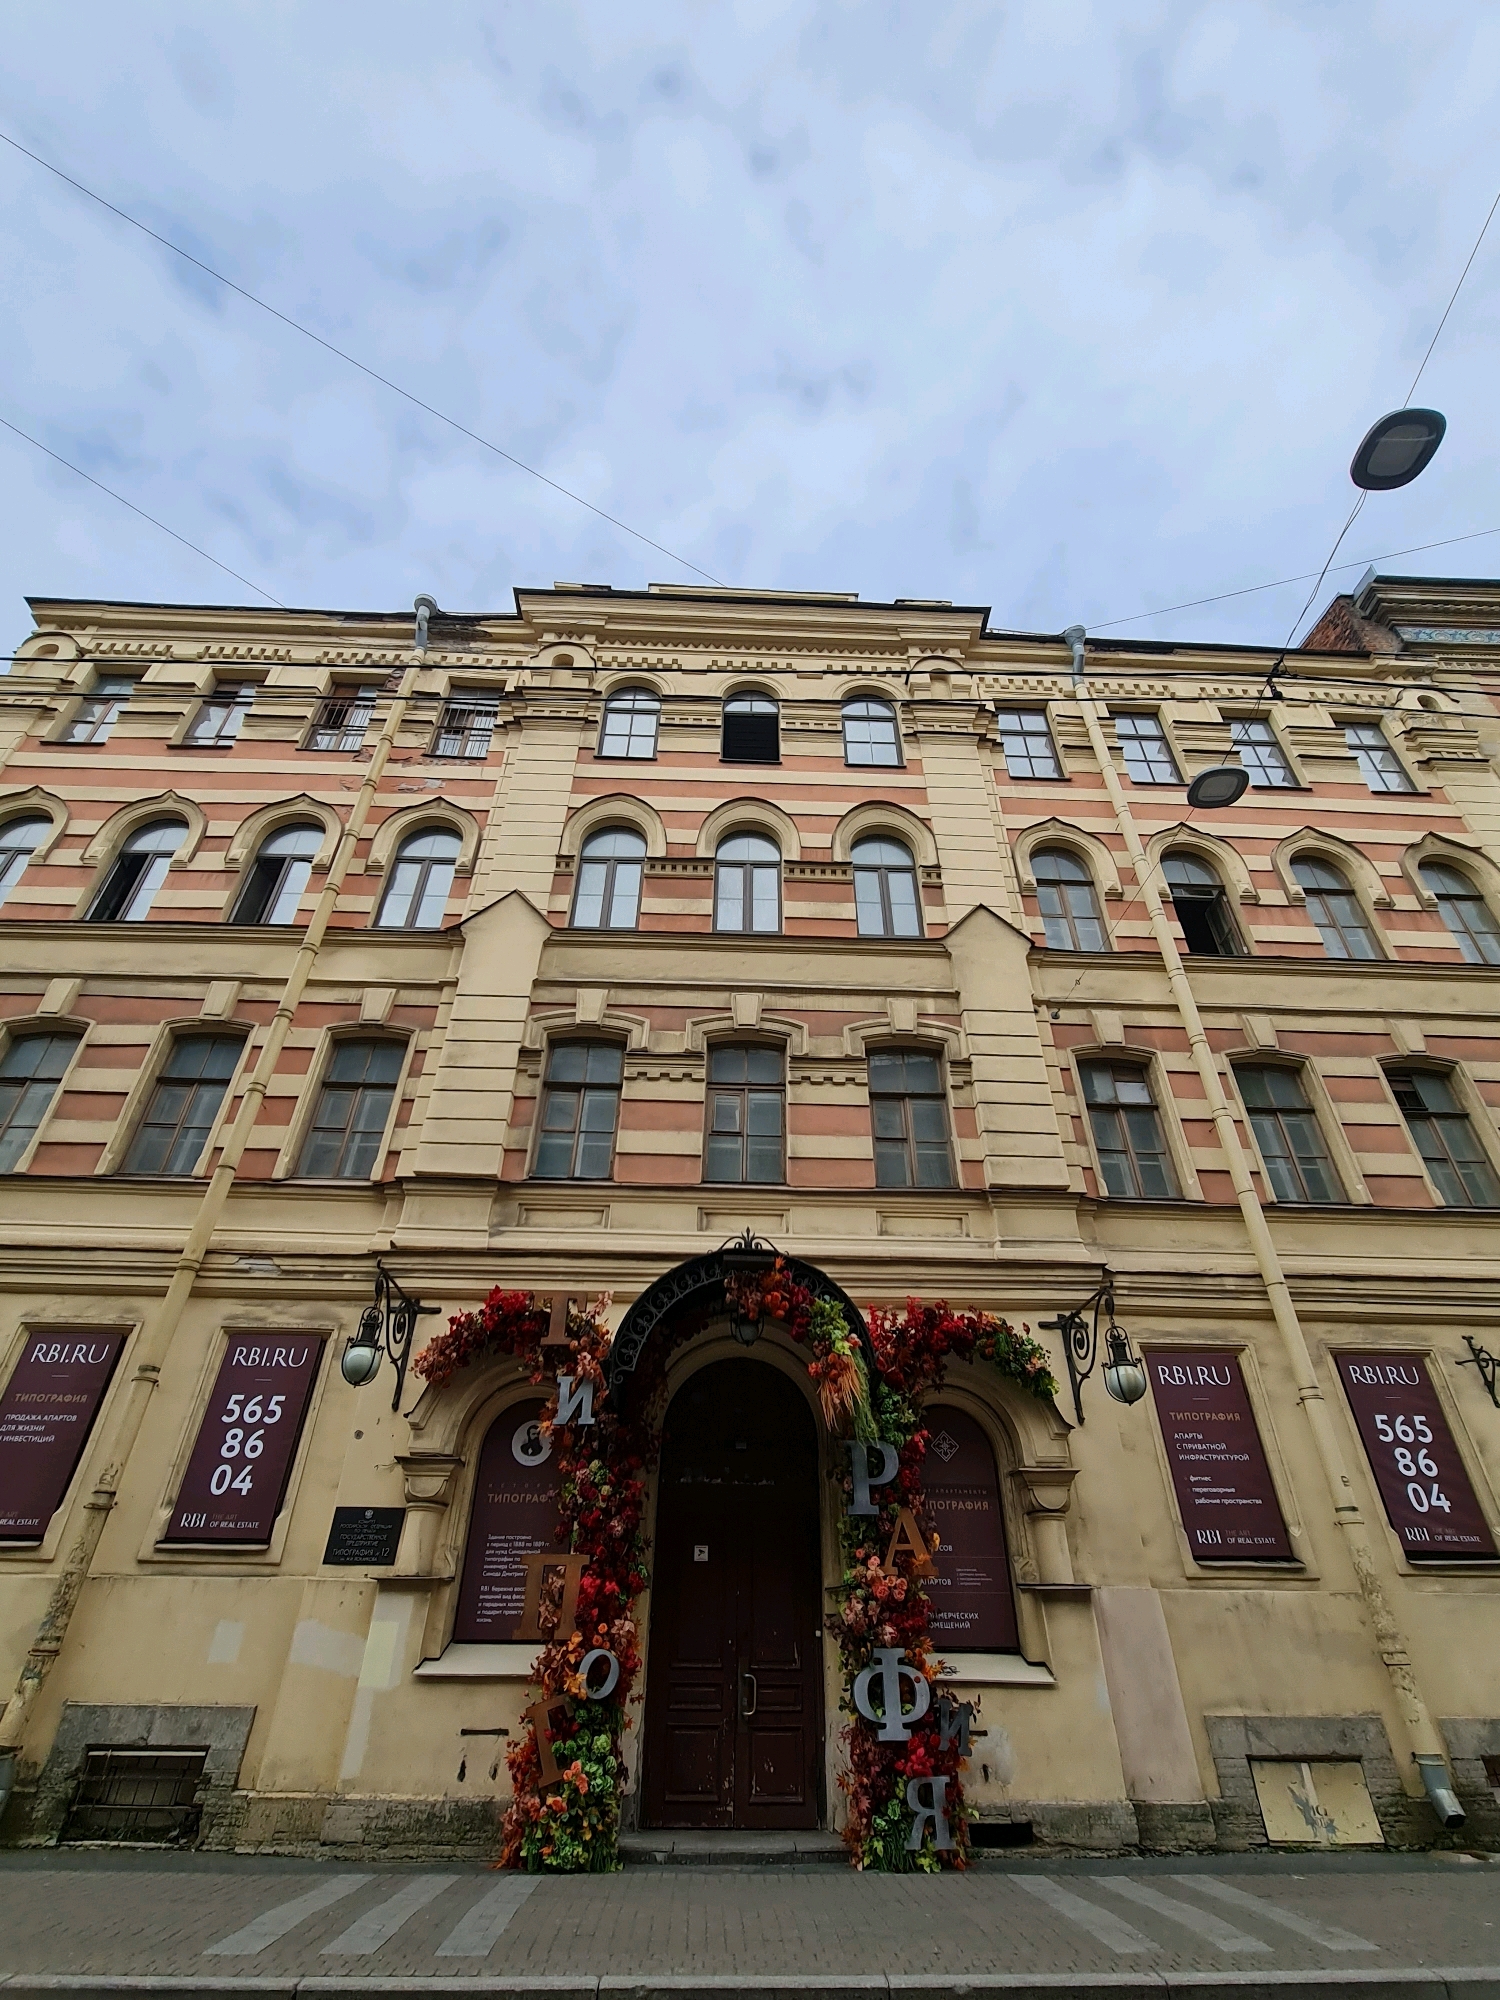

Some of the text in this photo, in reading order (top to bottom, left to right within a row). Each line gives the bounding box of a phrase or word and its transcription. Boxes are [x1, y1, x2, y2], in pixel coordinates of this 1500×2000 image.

[31, 1344, 110, 1363] RBI.RU
[232, 1347, 308, 1367] RBI.RU
[1158, 1366, 1231, 1386] RBI.RU
[1349, 1366, 1419, 1385] RBI.RU
[14, 1394, 88, 1403] ТИПОГРАФИЯ
[221, 1395, 286, 1424] 565
[1169, 1412, 1240, 1421] ТИПОГРАФИЯ
[3, 1434, 55, 1442] ИНВЕСТИЦИЙ
[1375, 1415, 1433, 1443] 565
[220, 1428, 265, 1459] 86
[1394, 1448, 1438, 1477] 86
[210, 1464, 253, 1496] 04
[488, 1494, 551, 1503] ТИПОГРАФ
[1407, 1483, 1451, 1513] 04
[180, 1513, 207, 1528] RBI
[1196, 1530, 1221, 1544] RBI
[1405, 1527, 1430, 1542] RBI
[382, 1548, 390, 1556] 12
[929, 1621, 970, 1629] ОМЕЩЕНИЙ
